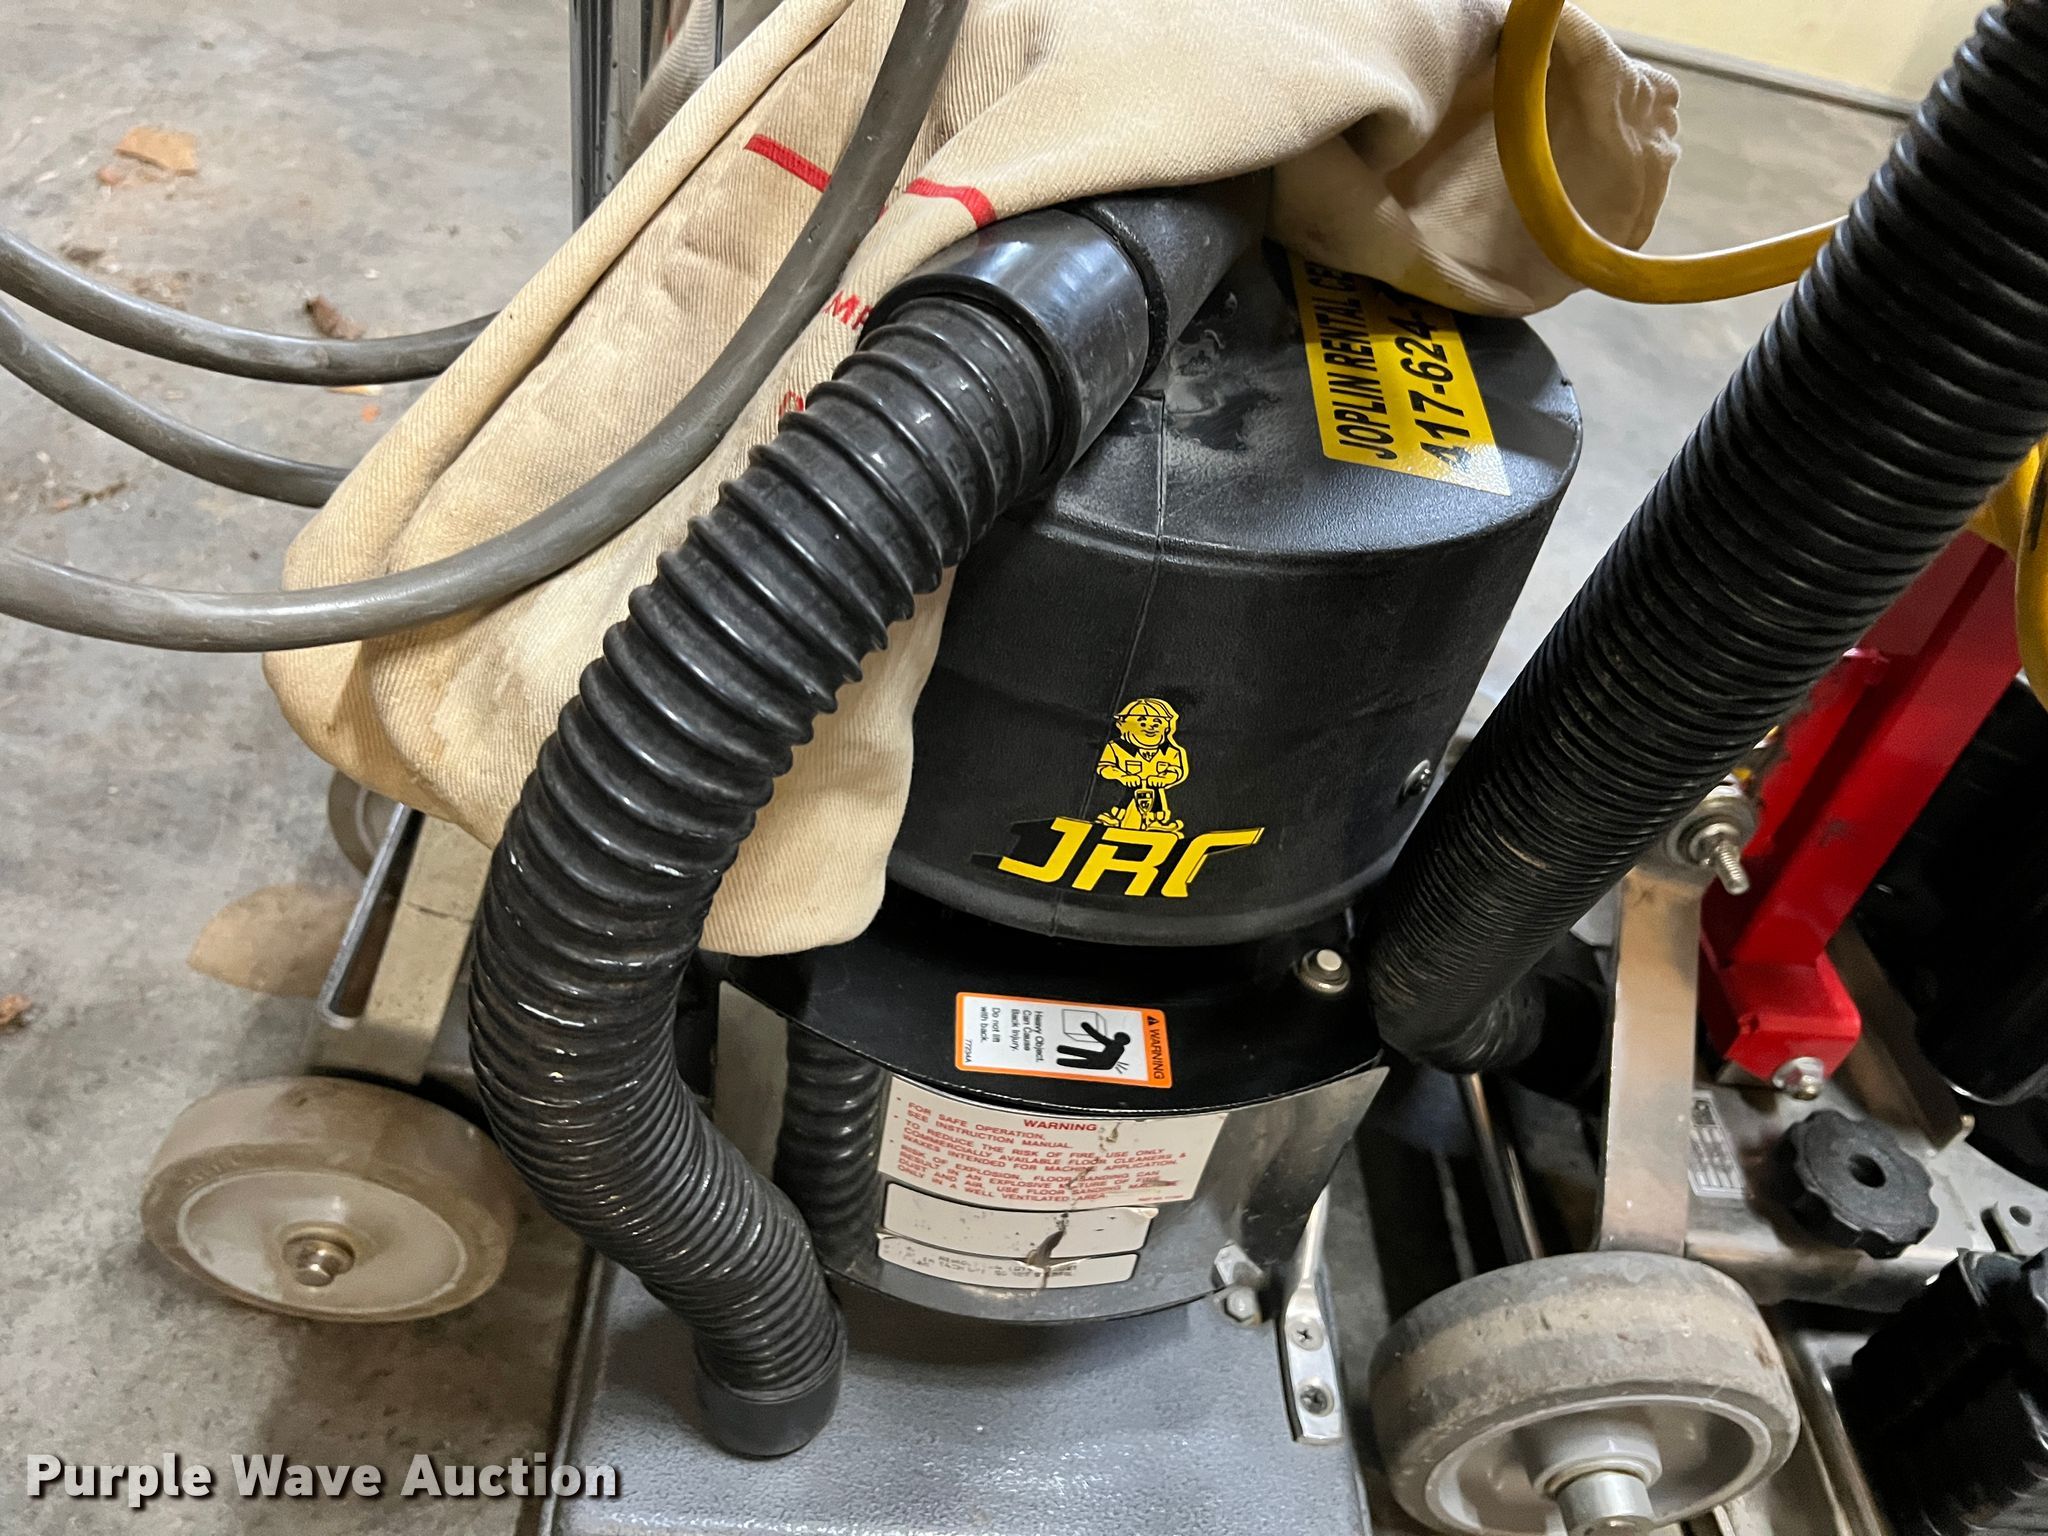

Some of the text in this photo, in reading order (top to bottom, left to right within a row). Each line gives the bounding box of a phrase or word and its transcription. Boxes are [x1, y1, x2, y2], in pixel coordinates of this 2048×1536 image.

[1312, 296, 1377, 372] RENTAL
[1327, 372, 1398, 460] JOPLIN
[992, 1007, 1000, 1043] Do not lift
[1011, 1009, 1020, 1027] Back
[1023, 1010, 1032, 1051] Can Cause
[1032, 1011, 1044, 1034] Heavy
[1149, 1029, 1165, 1080] WARNING
[907, 1110, 929, 1123] SEE
[936, 1121, 1014, 1144] INSTRUCTION
[908, 1102, 931, 1115] FOR
[939, 1114, 968, 1127] SAFE
[1024, 1119, 1097, 1131] WARNING
[903, 1134, 940, 1152] WAXES
[947, 1150, 1006, 1168] INTENDED
[904, 1127, 992, 1158] COMMERCIALLY
[999, 1154, 1061, 1165] AVAILABLE
[1068, 1157, 1107, 1166] FLOOR
[1114, 1154, 1172, 1164] CLEANERS
[905, 1119, 920, 1130] TO
[927, 1128, 974, 1147] REDUCE
[982, 1144, 1005, 1153] THE
[1012, 1149, 1039, 1157] RISK
[1136, 1148, 1165, 1156] ONLY
[932, 1156, 948, 1164] OF
[1136, 1170, 1160, 1178] CAN
